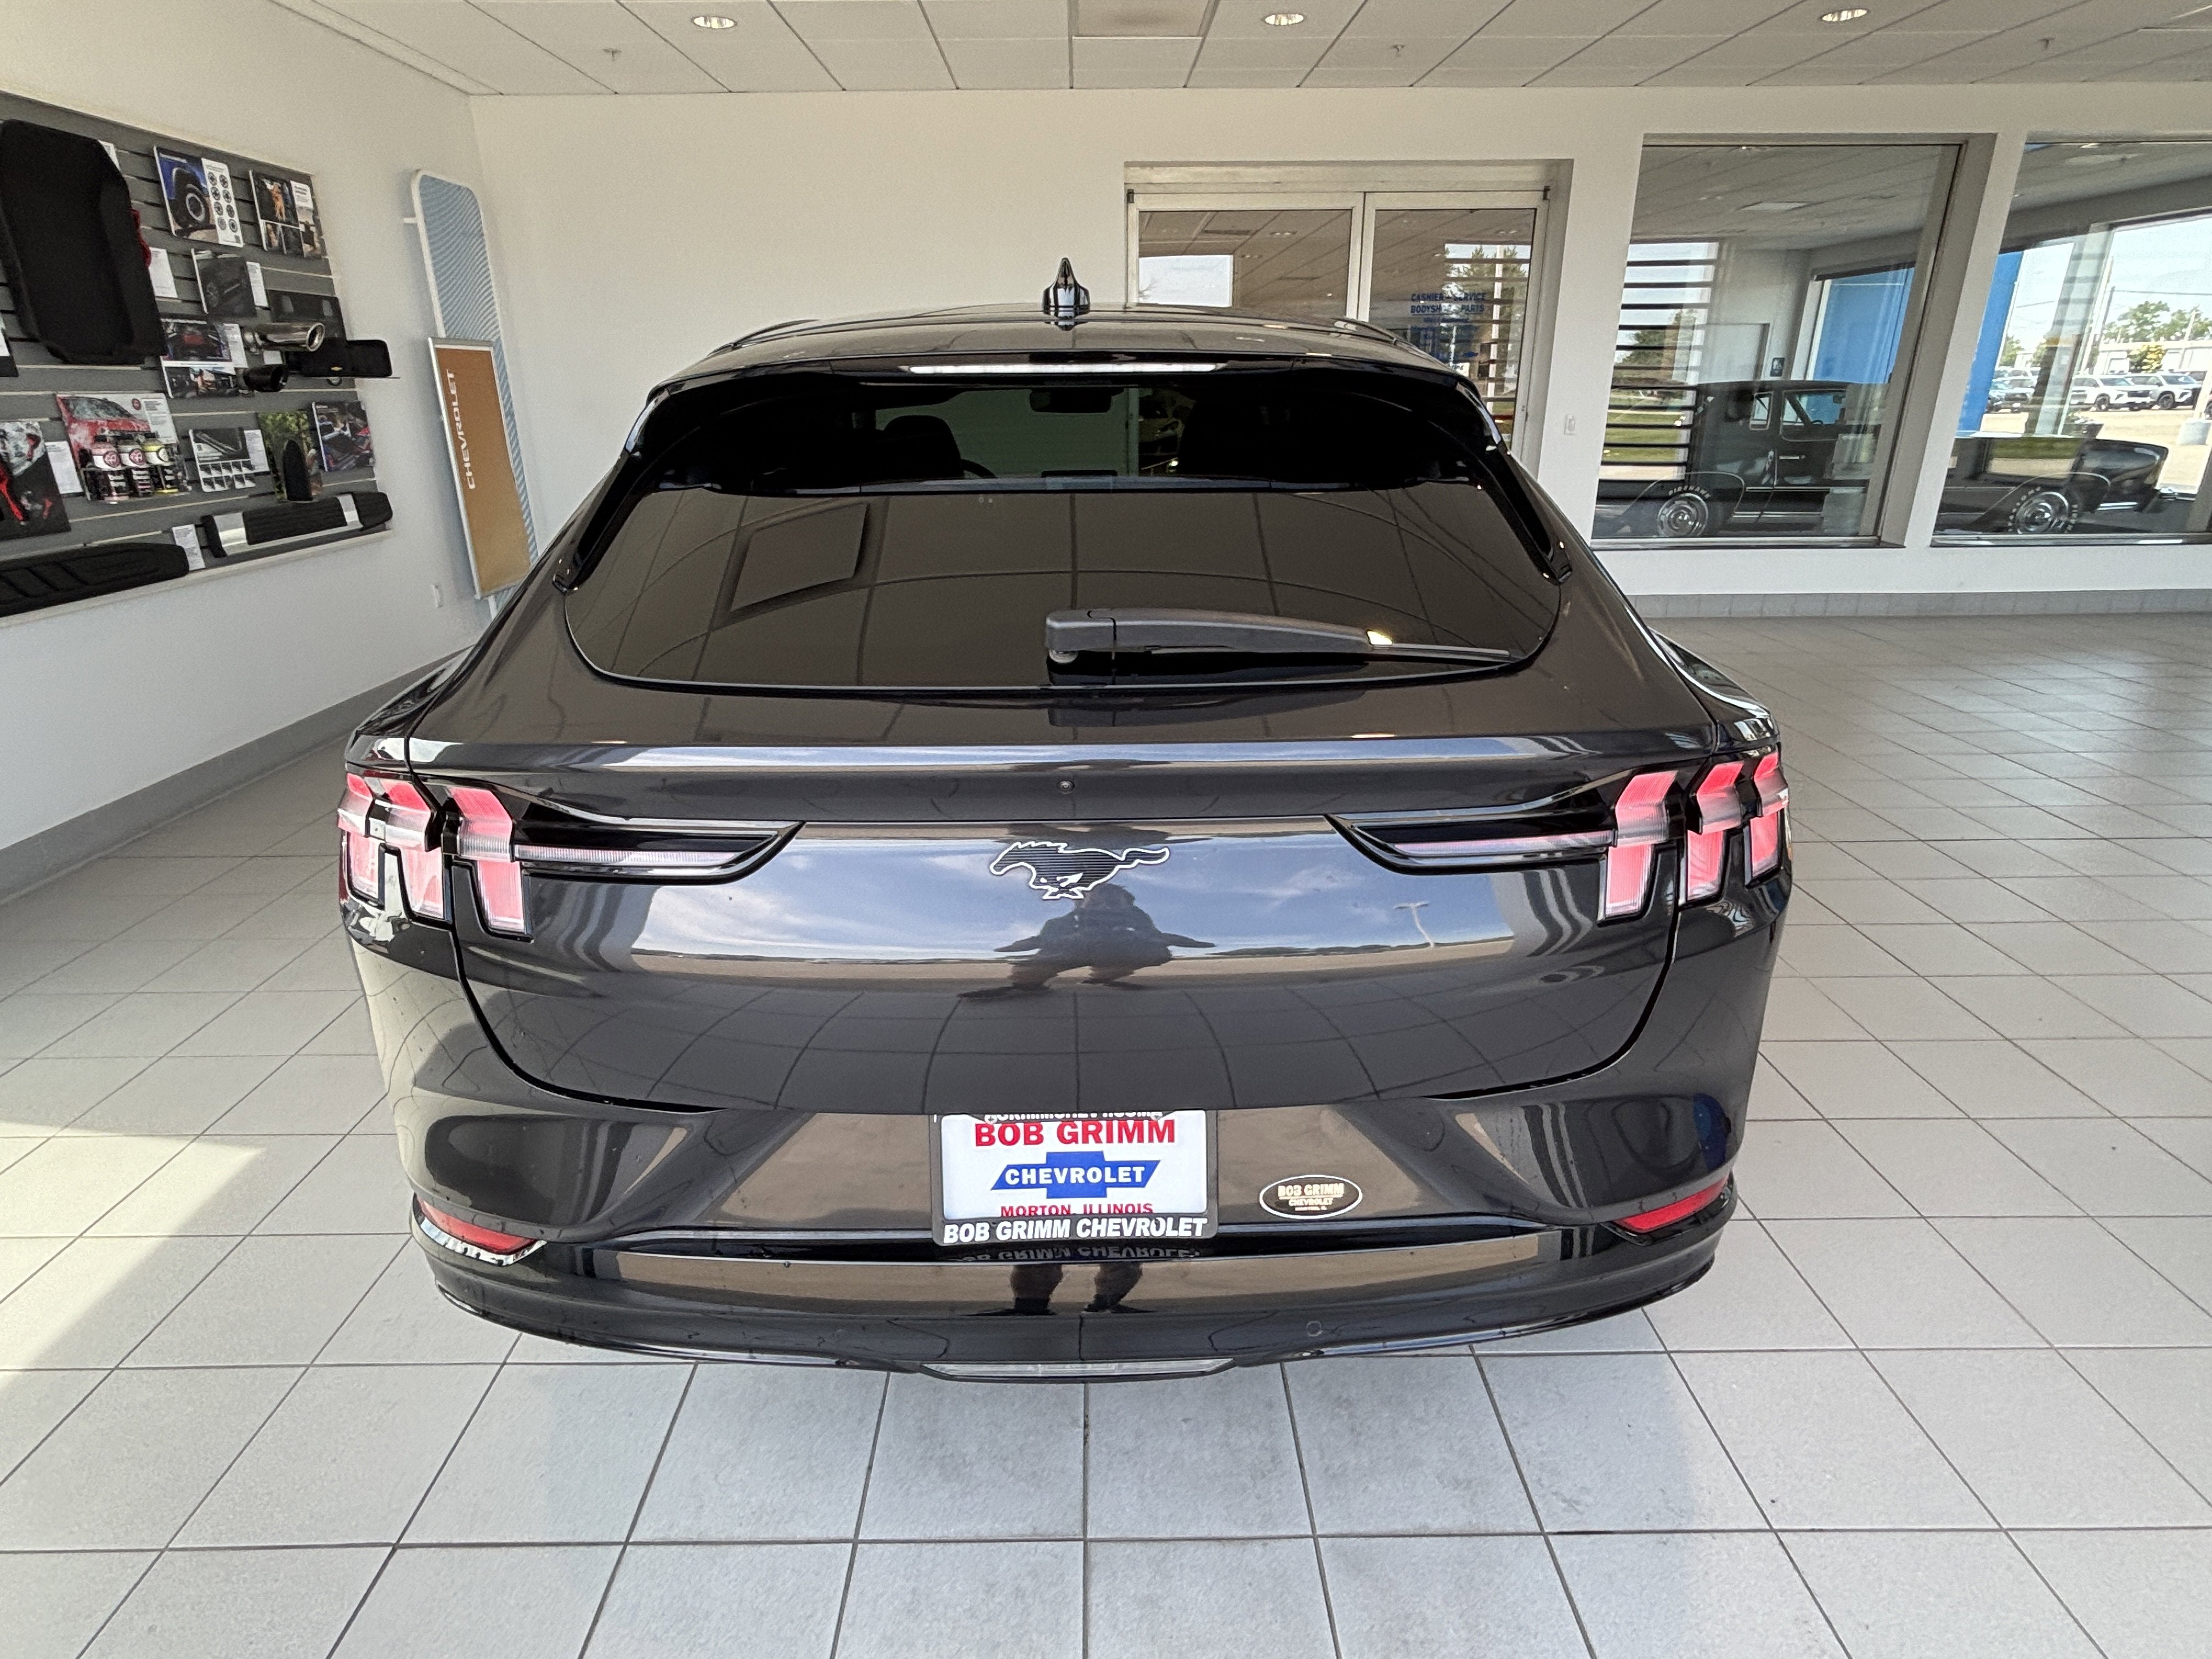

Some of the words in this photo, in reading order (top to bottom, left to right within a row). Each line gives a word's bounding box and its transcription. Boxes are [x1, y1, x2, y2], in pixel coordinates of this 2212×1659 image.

[1411, 293, 1444, 301] CASHIER
[1460, 304, 1485, 313] PARTS
[447, 369, 476, 489] CHEVROLET
[975, 1122, 1044, 1147] BOB
[1057, 1119, 1175, 1144] GRIMM
[1005, 1166, 1146, 1185] CHEVROLET
[1277, 1185, 1302, 1197] BOB
[1304, 1183, 1344, 1196] GRIMM
[943, 1222, 990, 1244] BOB
[996, 1218, 1071, 1241] GRIMM
[1076, 1217, 1207, 1238] CHEVROLET
